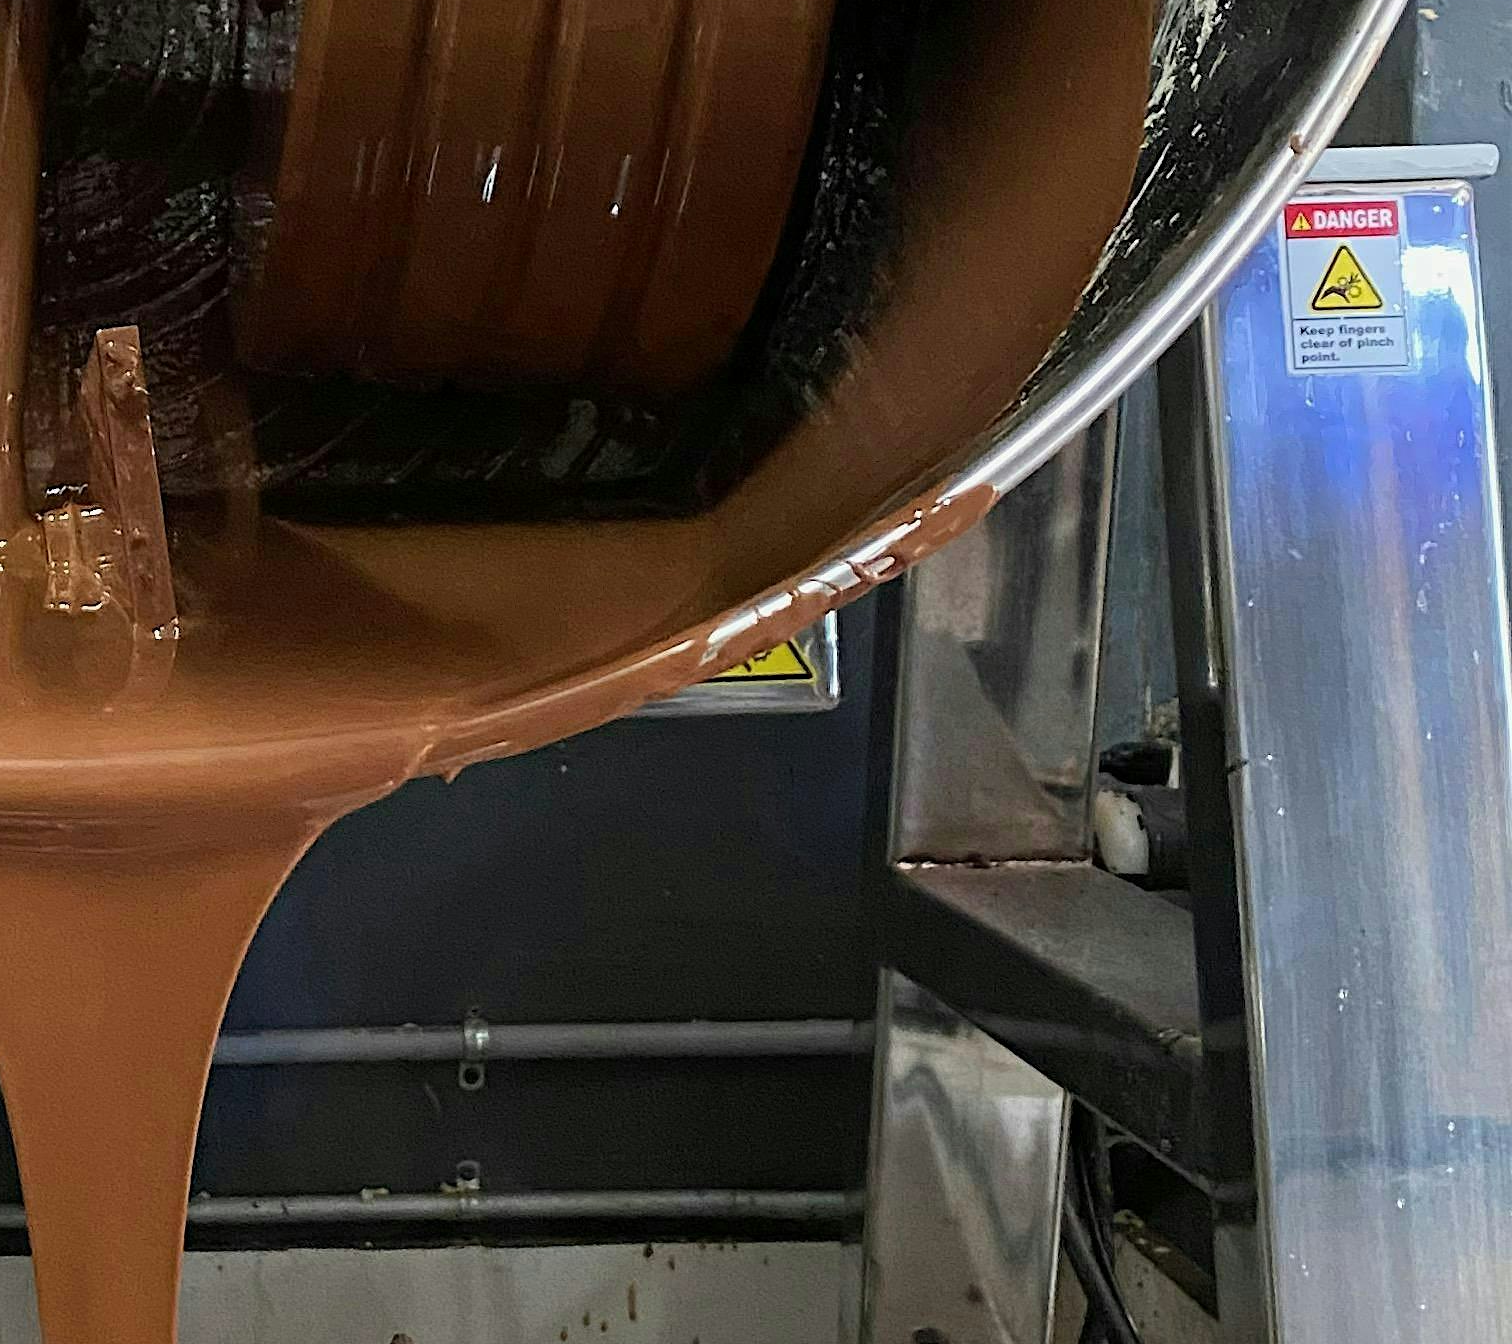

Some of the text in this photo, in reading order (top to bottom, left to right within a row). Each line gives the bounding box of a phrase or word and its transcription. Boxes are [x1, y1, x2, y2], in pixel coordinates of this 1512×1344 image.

[1312, 209, 1393, 230] DANGER
[1300, 324, 1386, 338] Keep fingers
[1300, 336, 1395, 350] clear of pinch
[1301, 352, 1341, 364] point.
